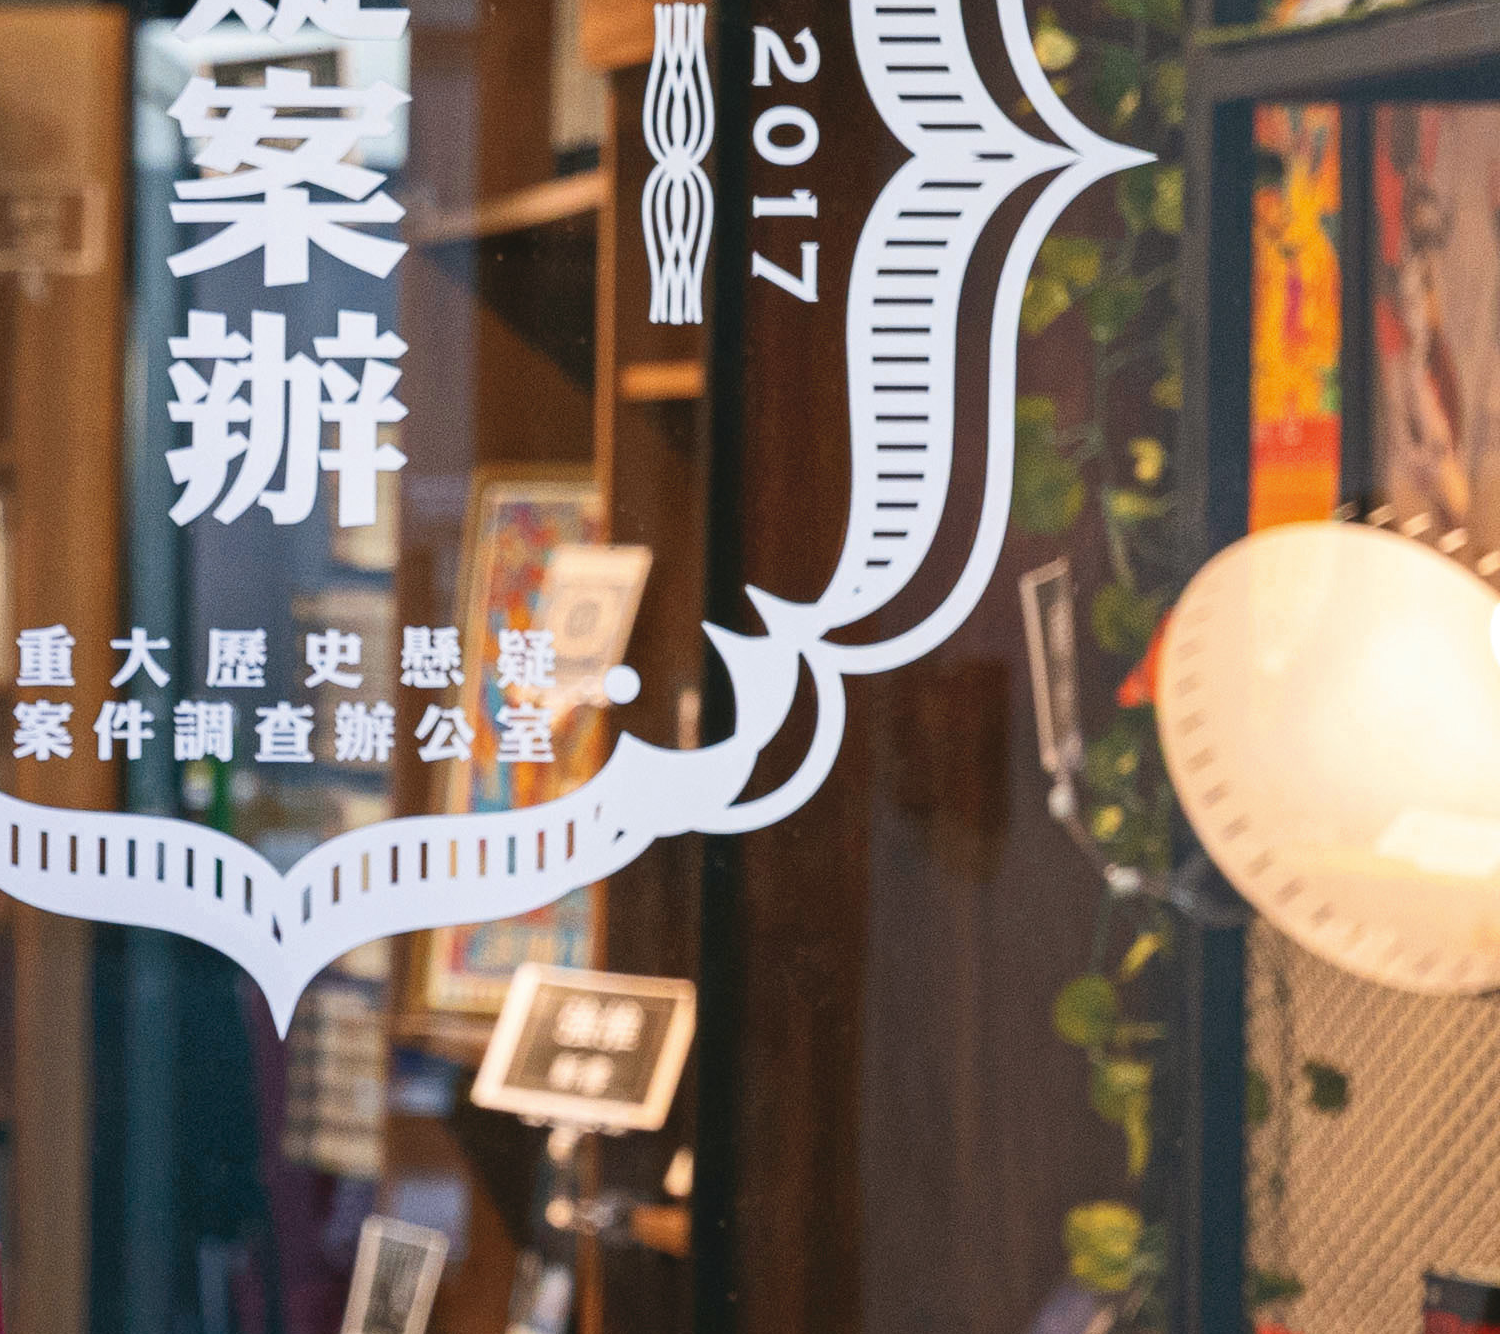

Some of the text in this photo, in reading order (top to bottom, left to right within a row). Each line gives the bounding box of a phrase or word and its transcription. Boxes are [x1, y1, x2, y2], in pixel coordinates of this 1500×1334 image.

[753, 28, 820, 302] 2017
[16, 624, 557, 689] 重大歷史懸疑
[13, 700, 555, 763] 案件調查辦公室
